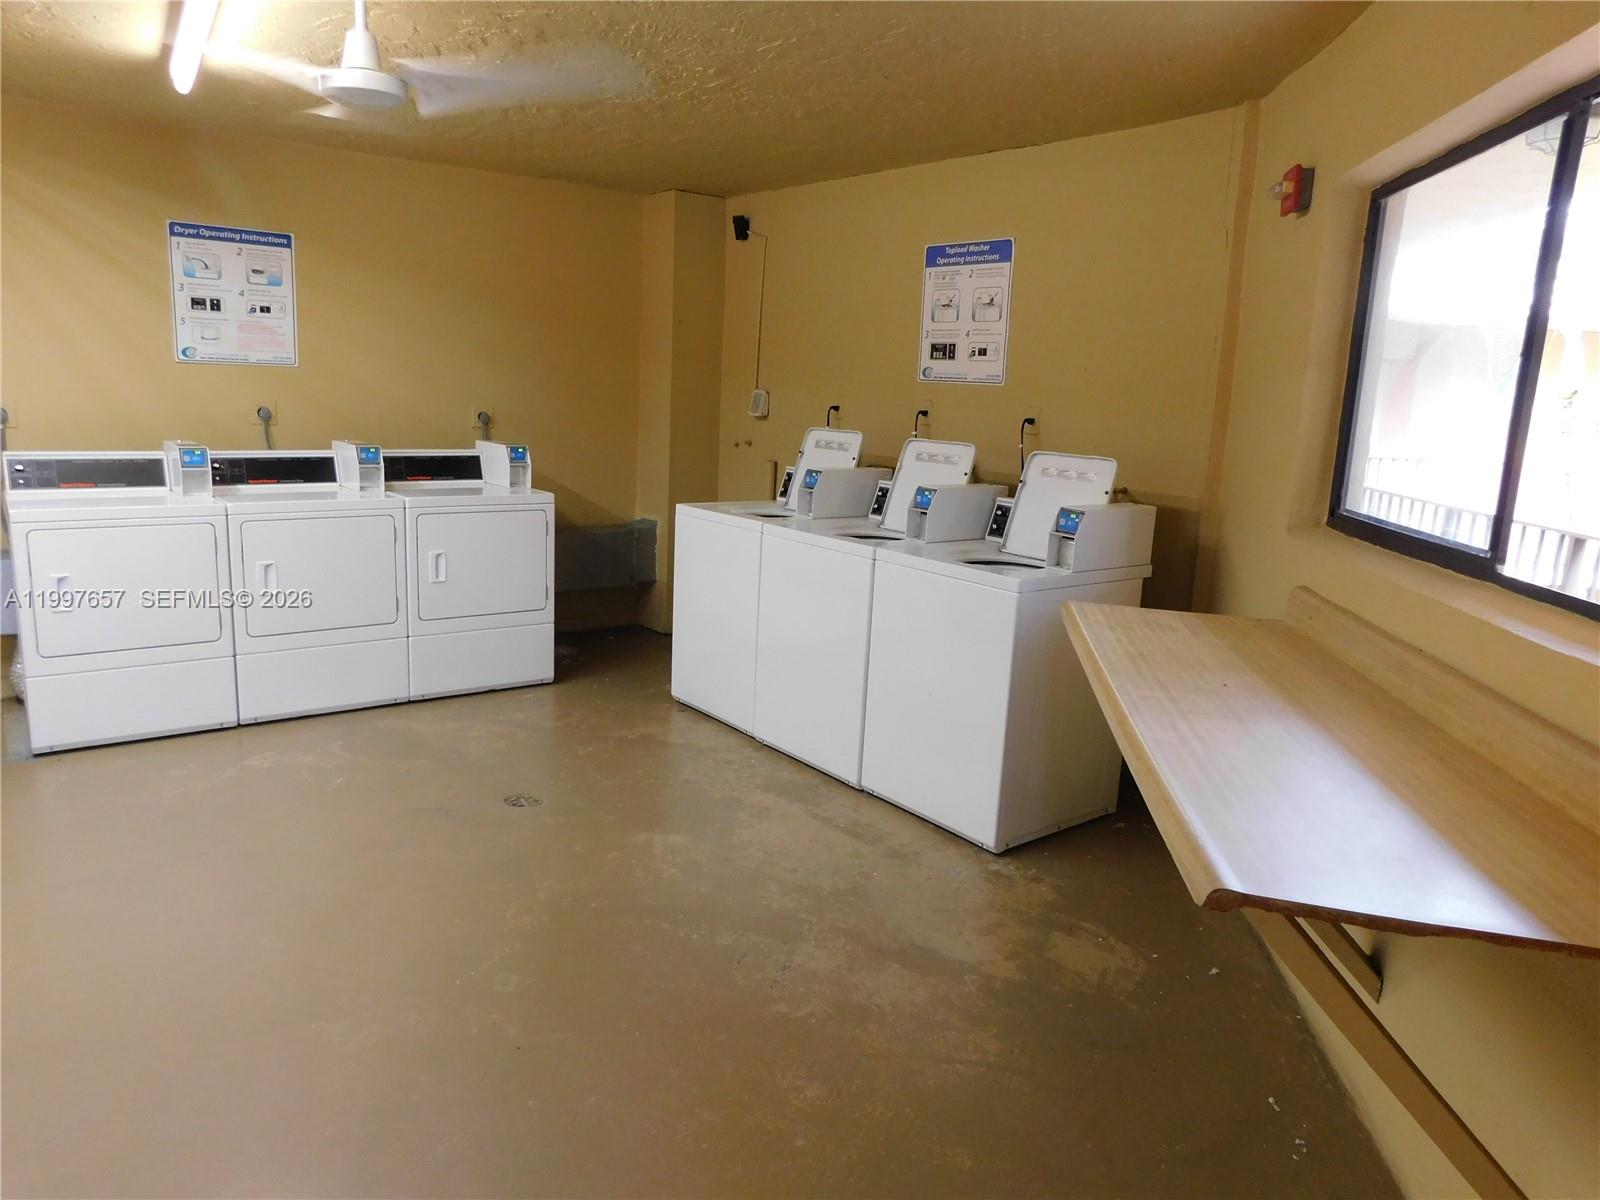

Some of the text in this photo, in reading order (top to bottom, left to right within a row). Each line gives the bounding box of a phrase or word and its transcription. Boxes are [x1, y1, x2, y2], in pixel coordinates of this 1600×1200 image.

[174, 226, 288, 244] Dryer Operating Instructions
[236, 247, 243, 256] 2
[945, 245, 991, 255] Topload Washer
[936, 253, 1000, 264] Operating Instructions
[969, 269, 974, 278] 2
[177, 282, 185, 292] 3
[238, 289, 245, 298] 4
